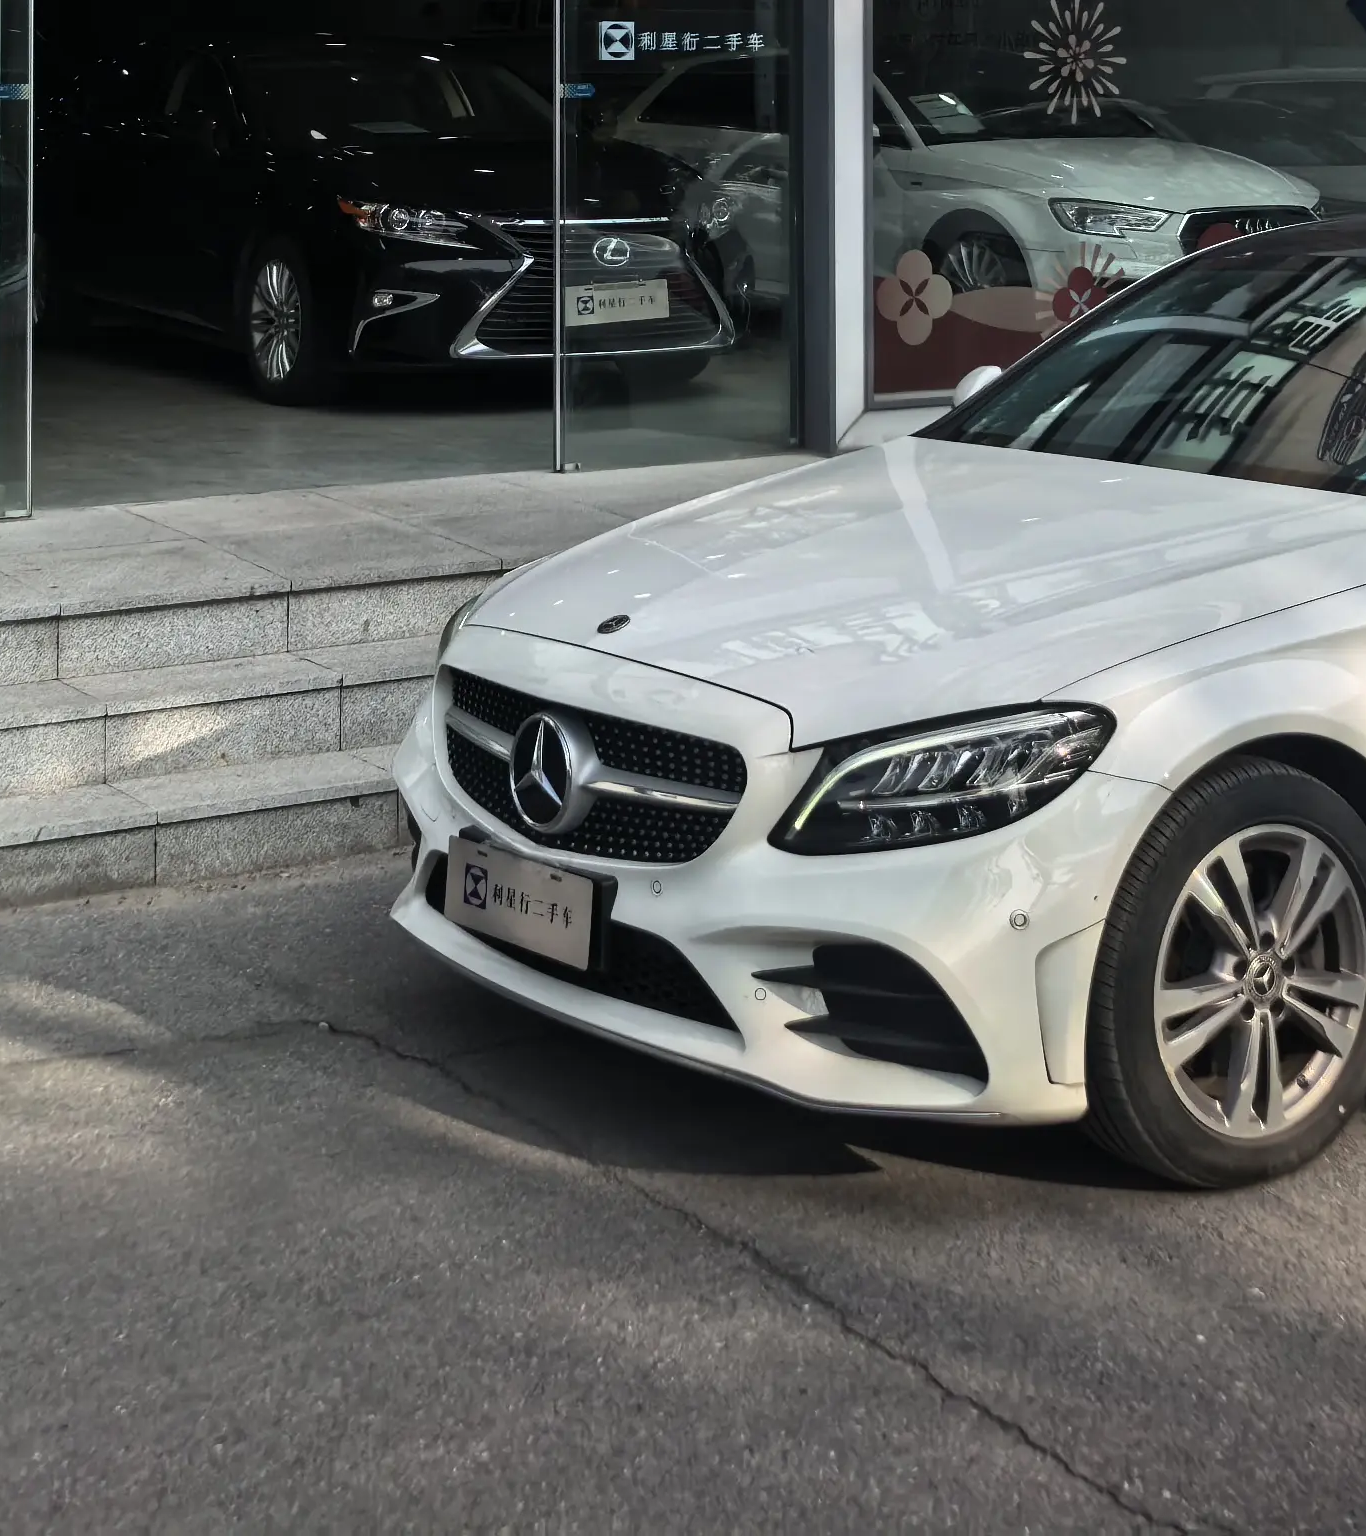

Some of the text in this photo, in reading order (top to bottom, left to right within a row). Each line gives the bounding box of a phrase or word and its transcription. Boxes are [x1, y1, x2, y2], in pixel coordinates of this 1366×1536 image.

[637, 31, 766, 52] 利星行二手车
[492, 883, 573, 930] 利星行二手车
